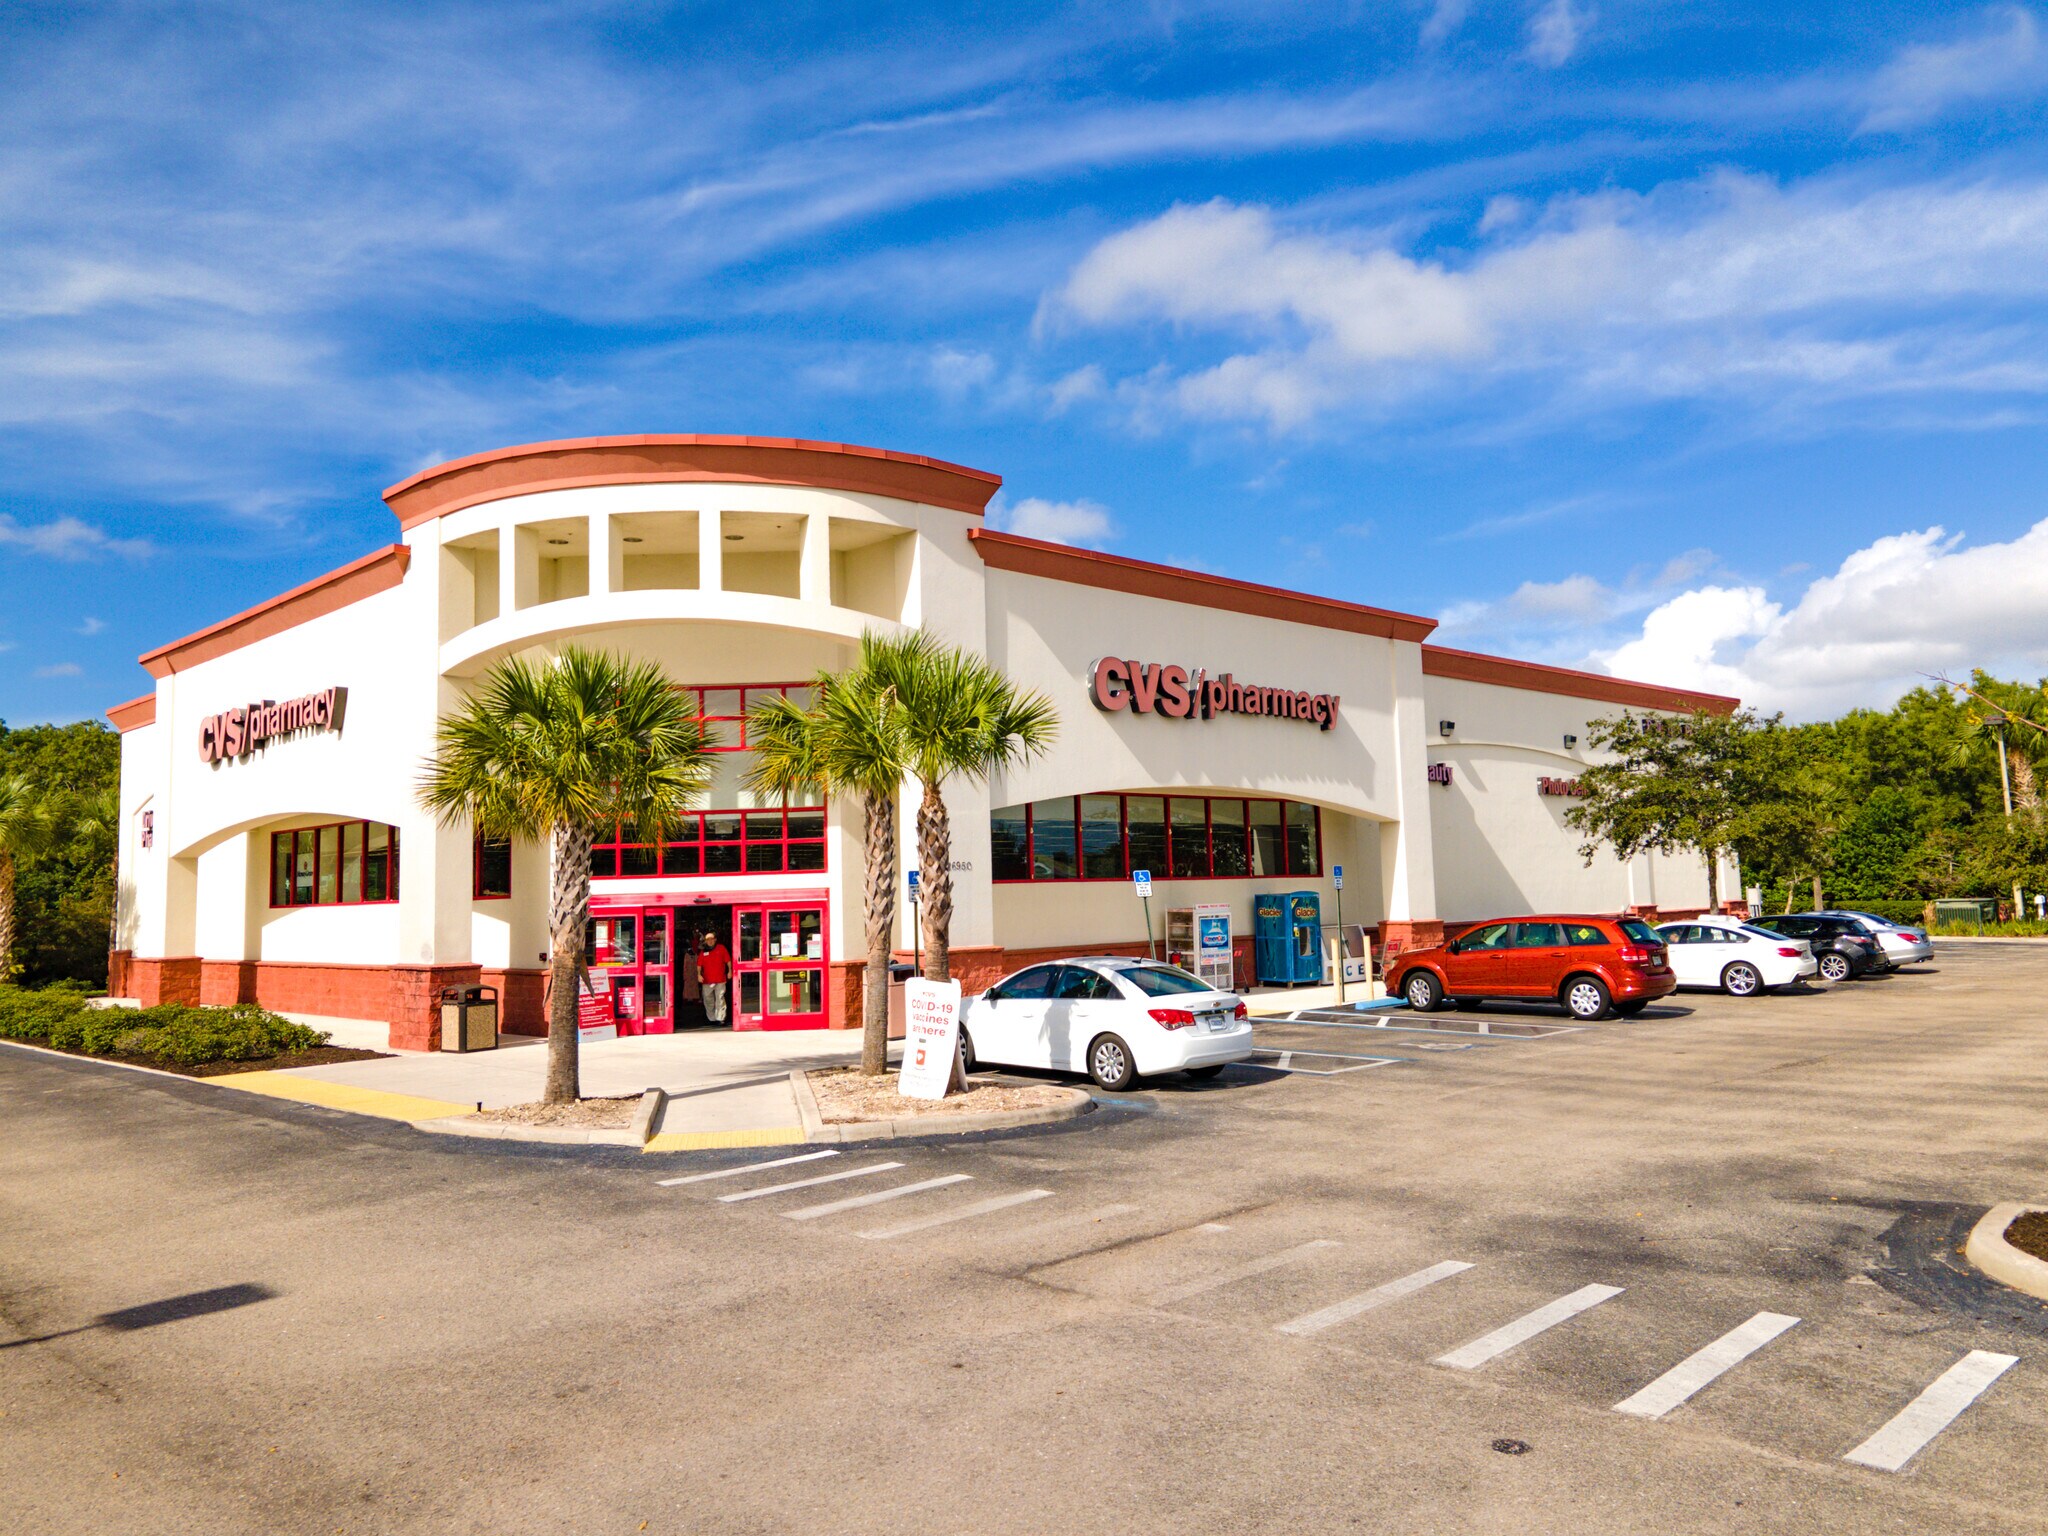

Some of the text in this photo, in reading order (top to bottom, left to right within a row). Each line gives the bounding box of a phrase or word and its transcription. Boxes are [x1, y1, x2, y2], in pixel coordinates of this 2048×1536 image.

[1428, 763, 1453, 785] auty
[1540, 776, 1569, 796] Photo
[1258, 907, 1282, 917] Glacier
[911, 998, 953, 1014] COVID-19
[912, 1012, 949, 1026] vaccines
